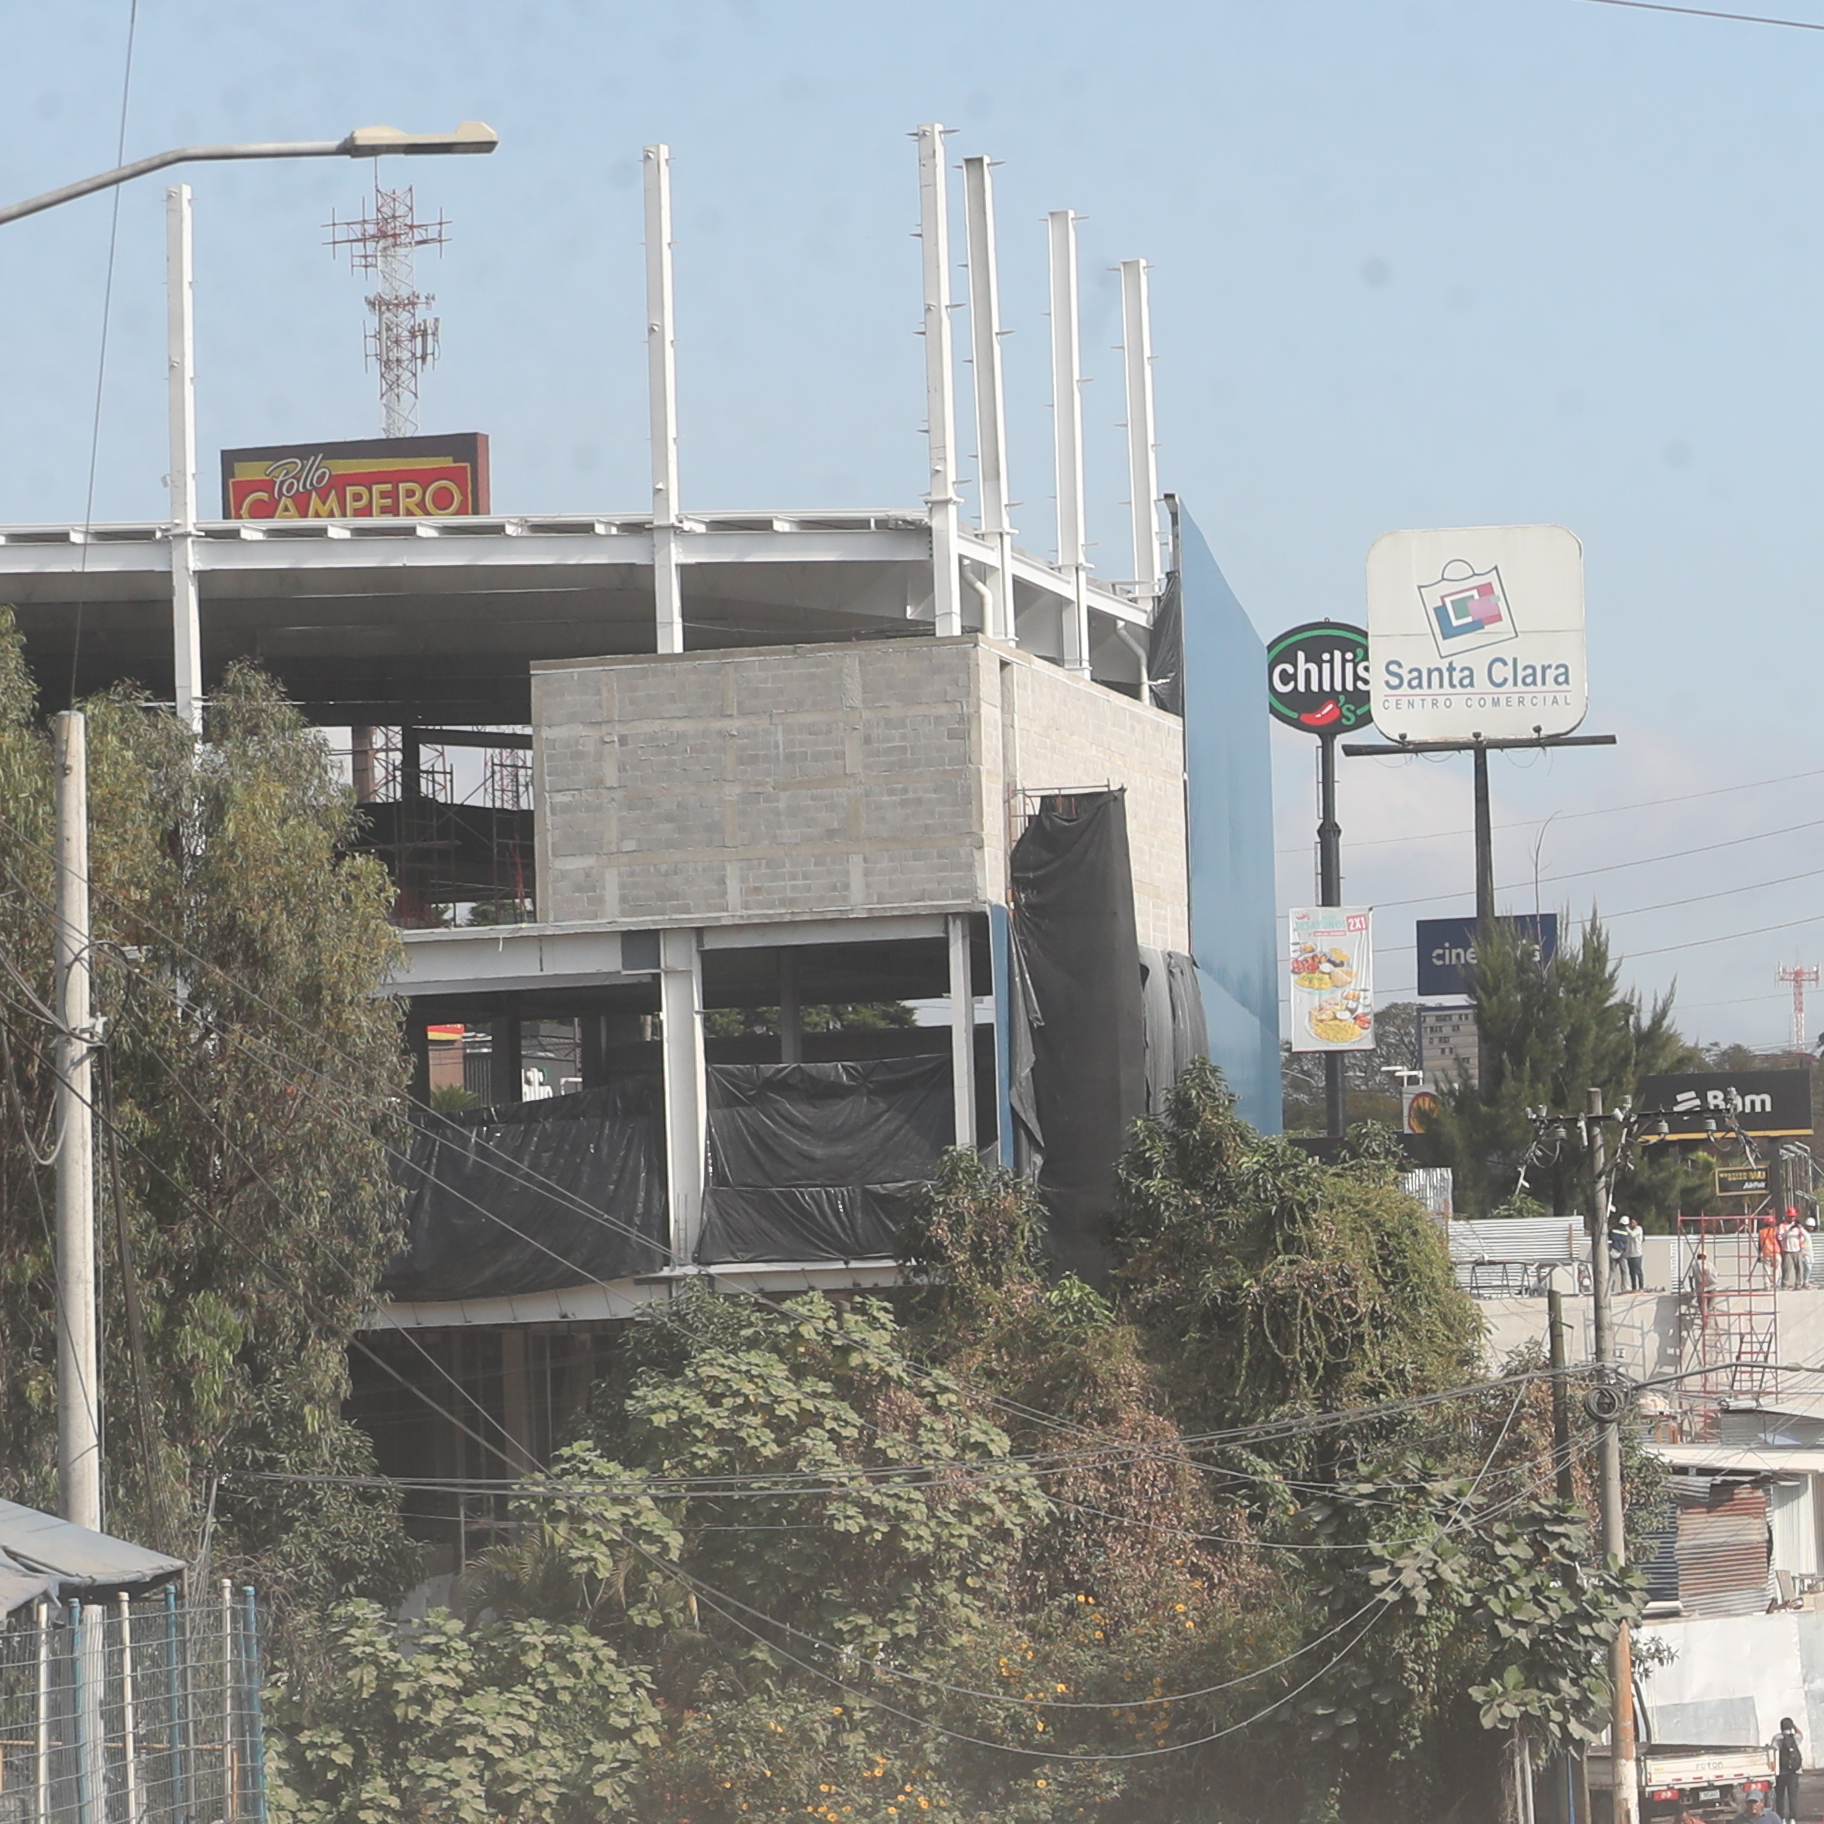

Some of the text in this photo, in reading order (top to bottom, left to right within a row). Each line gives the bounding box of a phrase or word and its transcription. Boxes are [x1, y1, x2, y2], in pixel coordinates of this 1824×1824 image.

[265, 453, 330, 500] Pollo
[240, 479, 464, 517] CAMPERO
[1272, 647, 1370, 693] chili's
[1384, 656, 1571, 691] Santa Clara
[1381, 694, 1572, 710] CENTRO COMERCIAL
